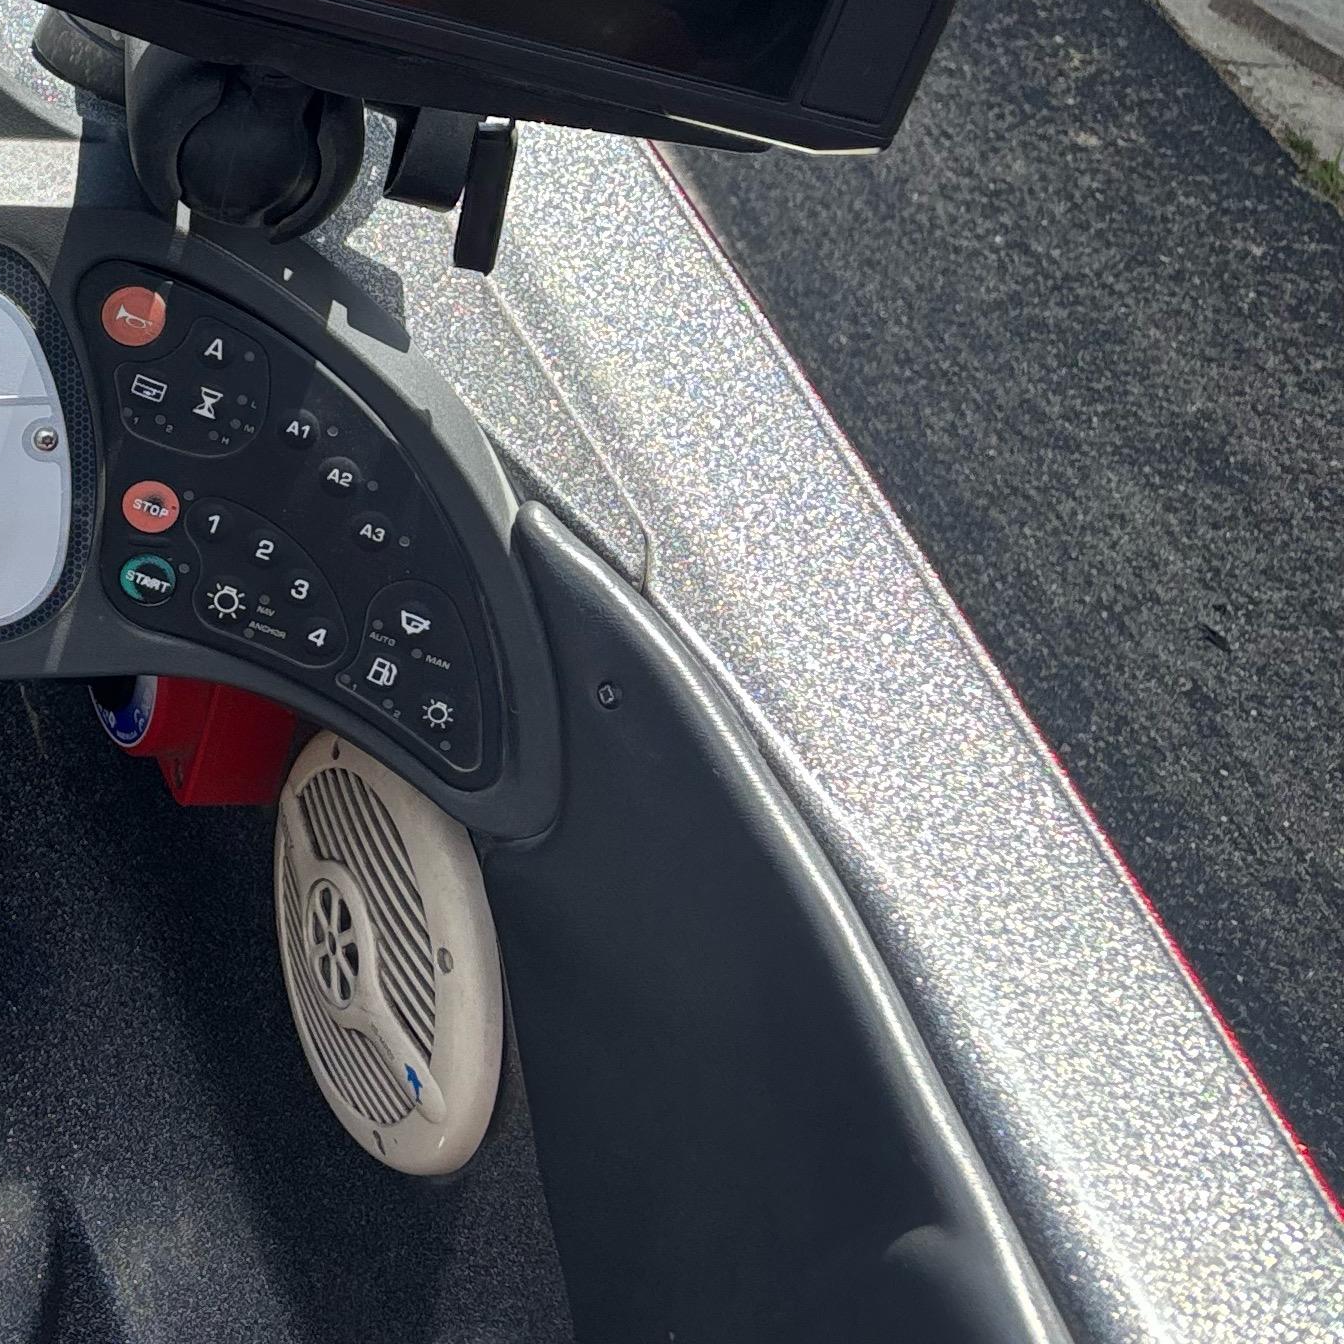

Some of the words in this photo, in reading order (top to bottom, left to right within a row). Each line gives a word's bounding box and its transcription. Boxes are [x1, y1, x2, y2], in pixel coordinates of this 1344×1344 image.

[204, 338, 224, 360] A
[165, 424, 173, 433] 2
[243, 423, 255, 434] M
[286, 420, 311, 439] A1
[221, 436, 230, 446] H
[326, 468, 353, 488] A2
[133, 498, 170, 519] STOP
[208, 515, 221, 534] 1
[359, 524, 386, 543] A3
[255, 539, 275, 561] 2
[125, 569, 171, 593] START
[290, 579, 310, 600] 3
[256, 606, 275, 617] NAV
[248, 620, 287, 640] ANCHOR
[307, 628, 328, 648] 4
[369, 631, 396, 647] AUTO
[425, 655, 451, 671] MAN
[393, 709, 402, 719] 2
